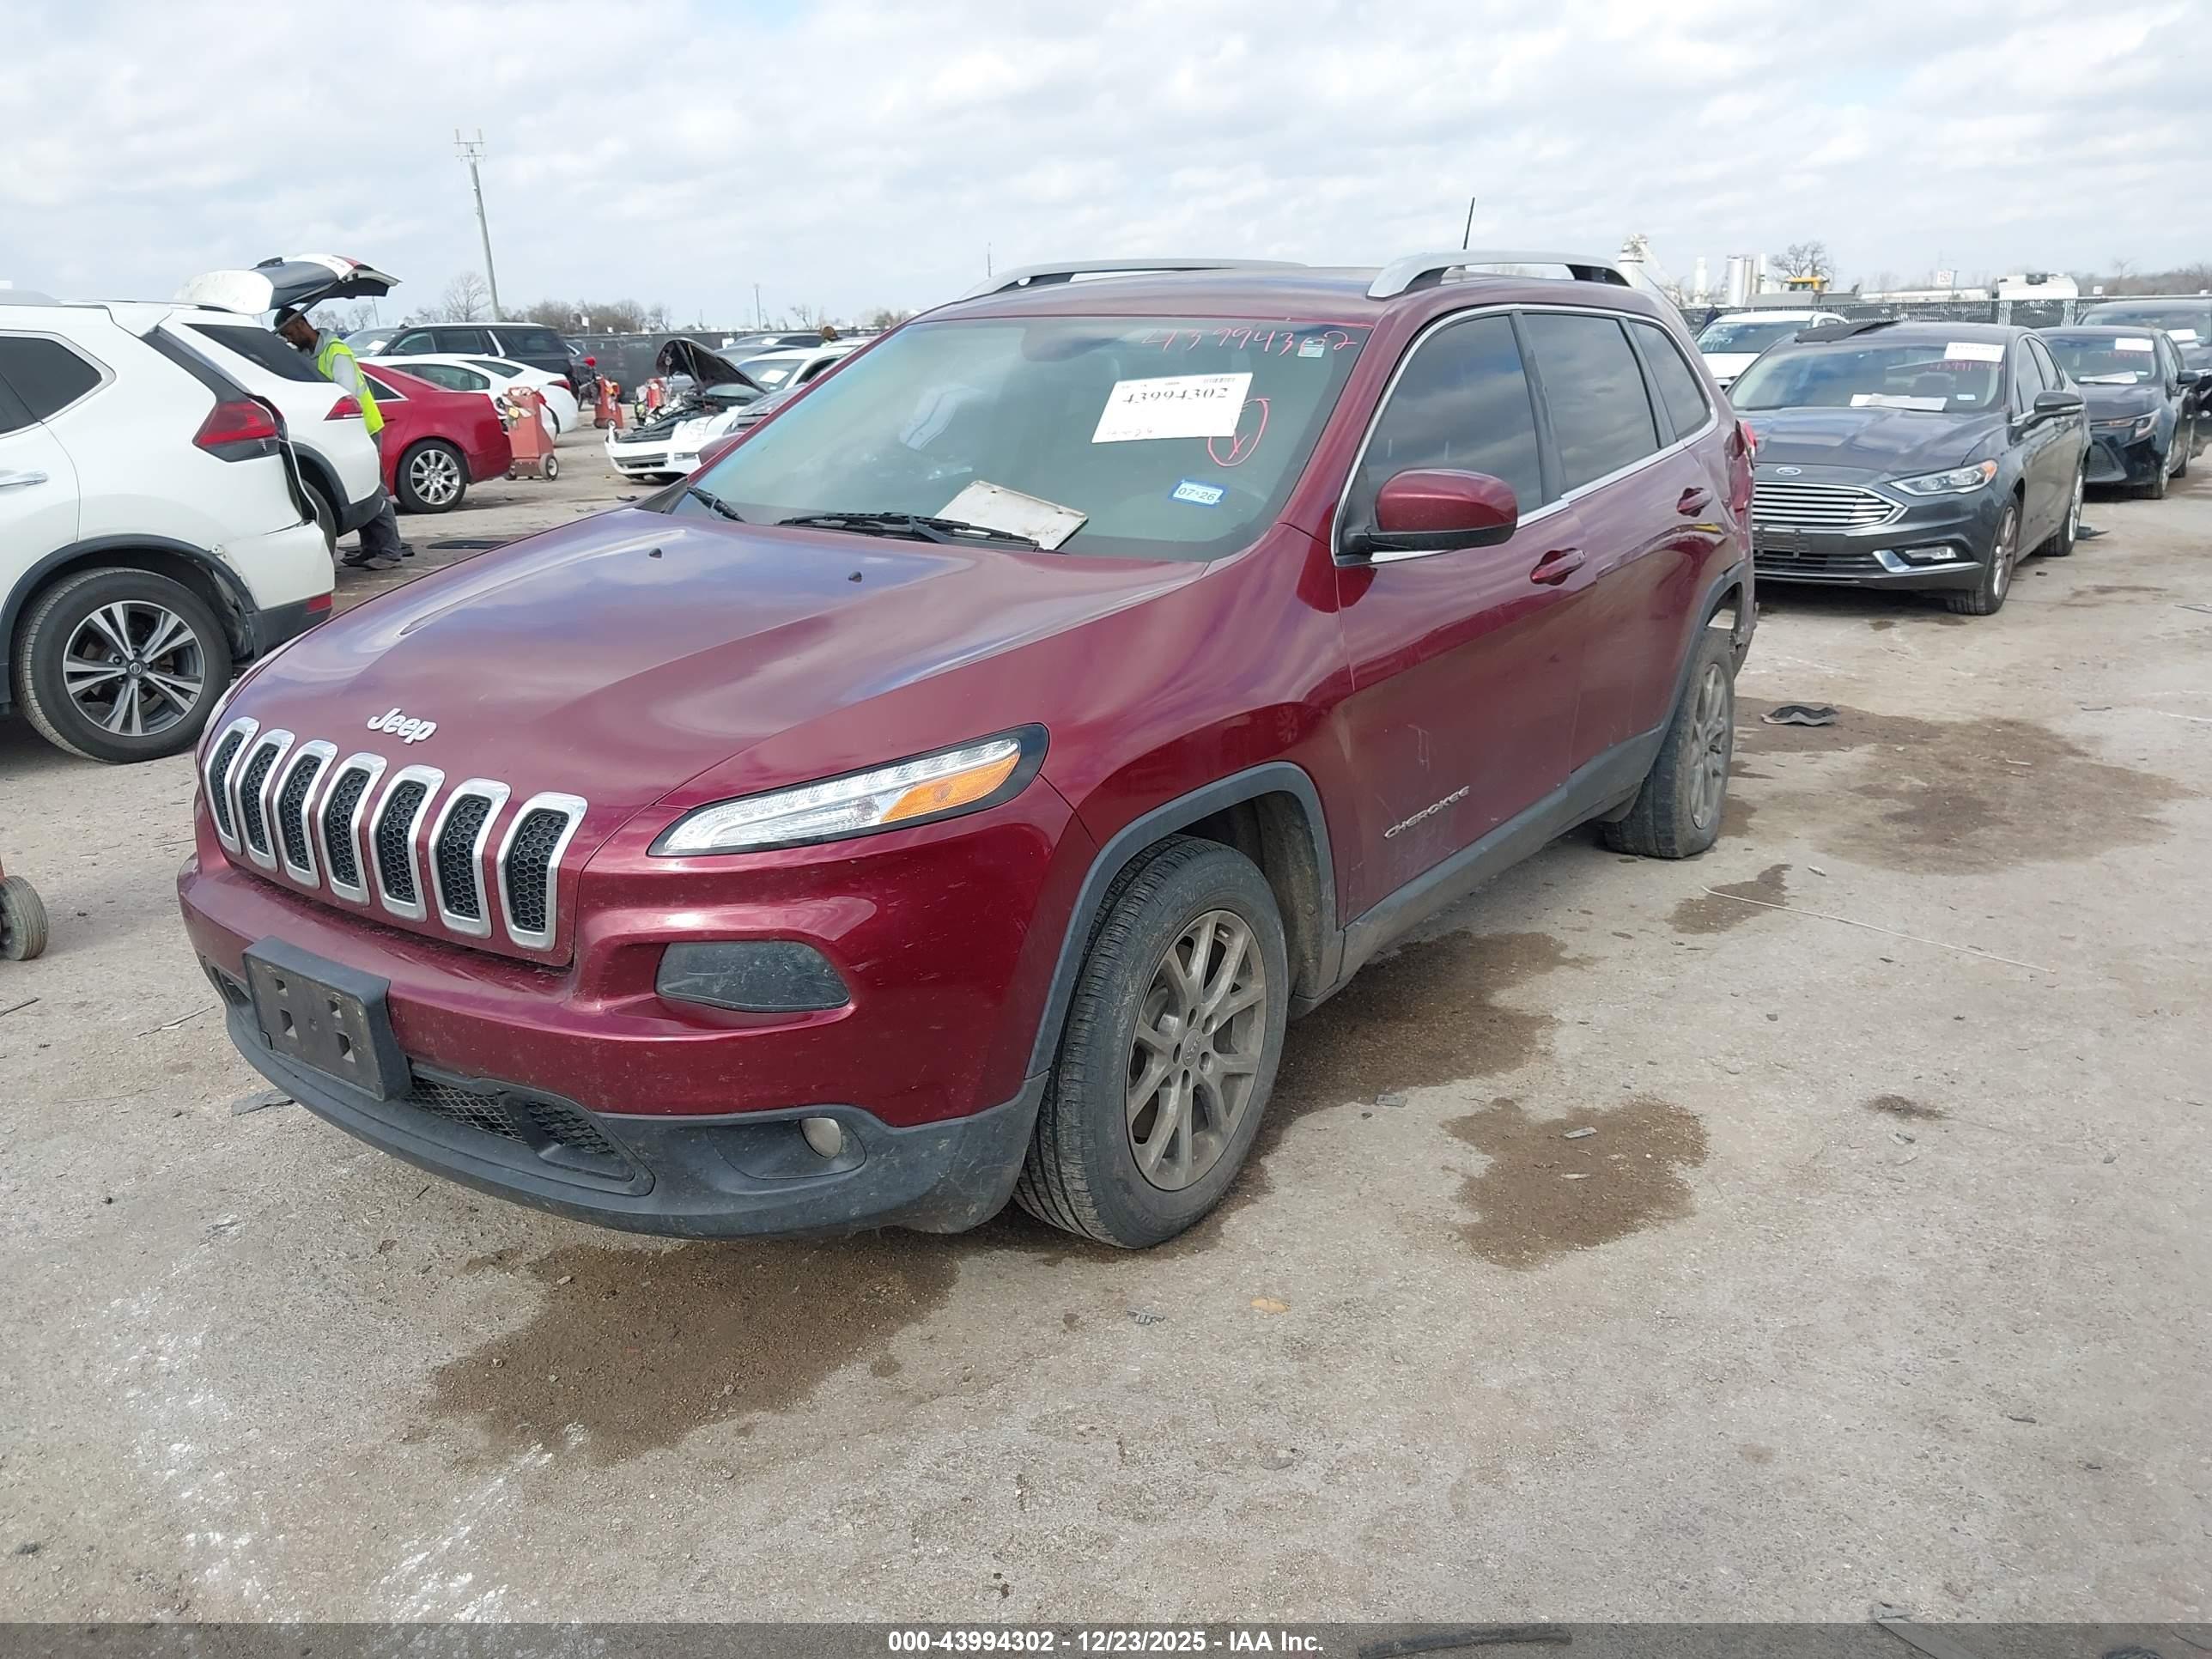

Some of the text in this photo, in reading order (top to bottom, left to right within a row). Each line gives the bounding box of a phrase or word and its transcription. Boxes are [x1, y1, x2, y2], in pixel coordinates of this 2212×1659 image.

[1121, 386, 1229, 404] 43994302
[367, 708, 438, 744] Jeep
[1384, 785, 1470, 839] CHEROKEE
